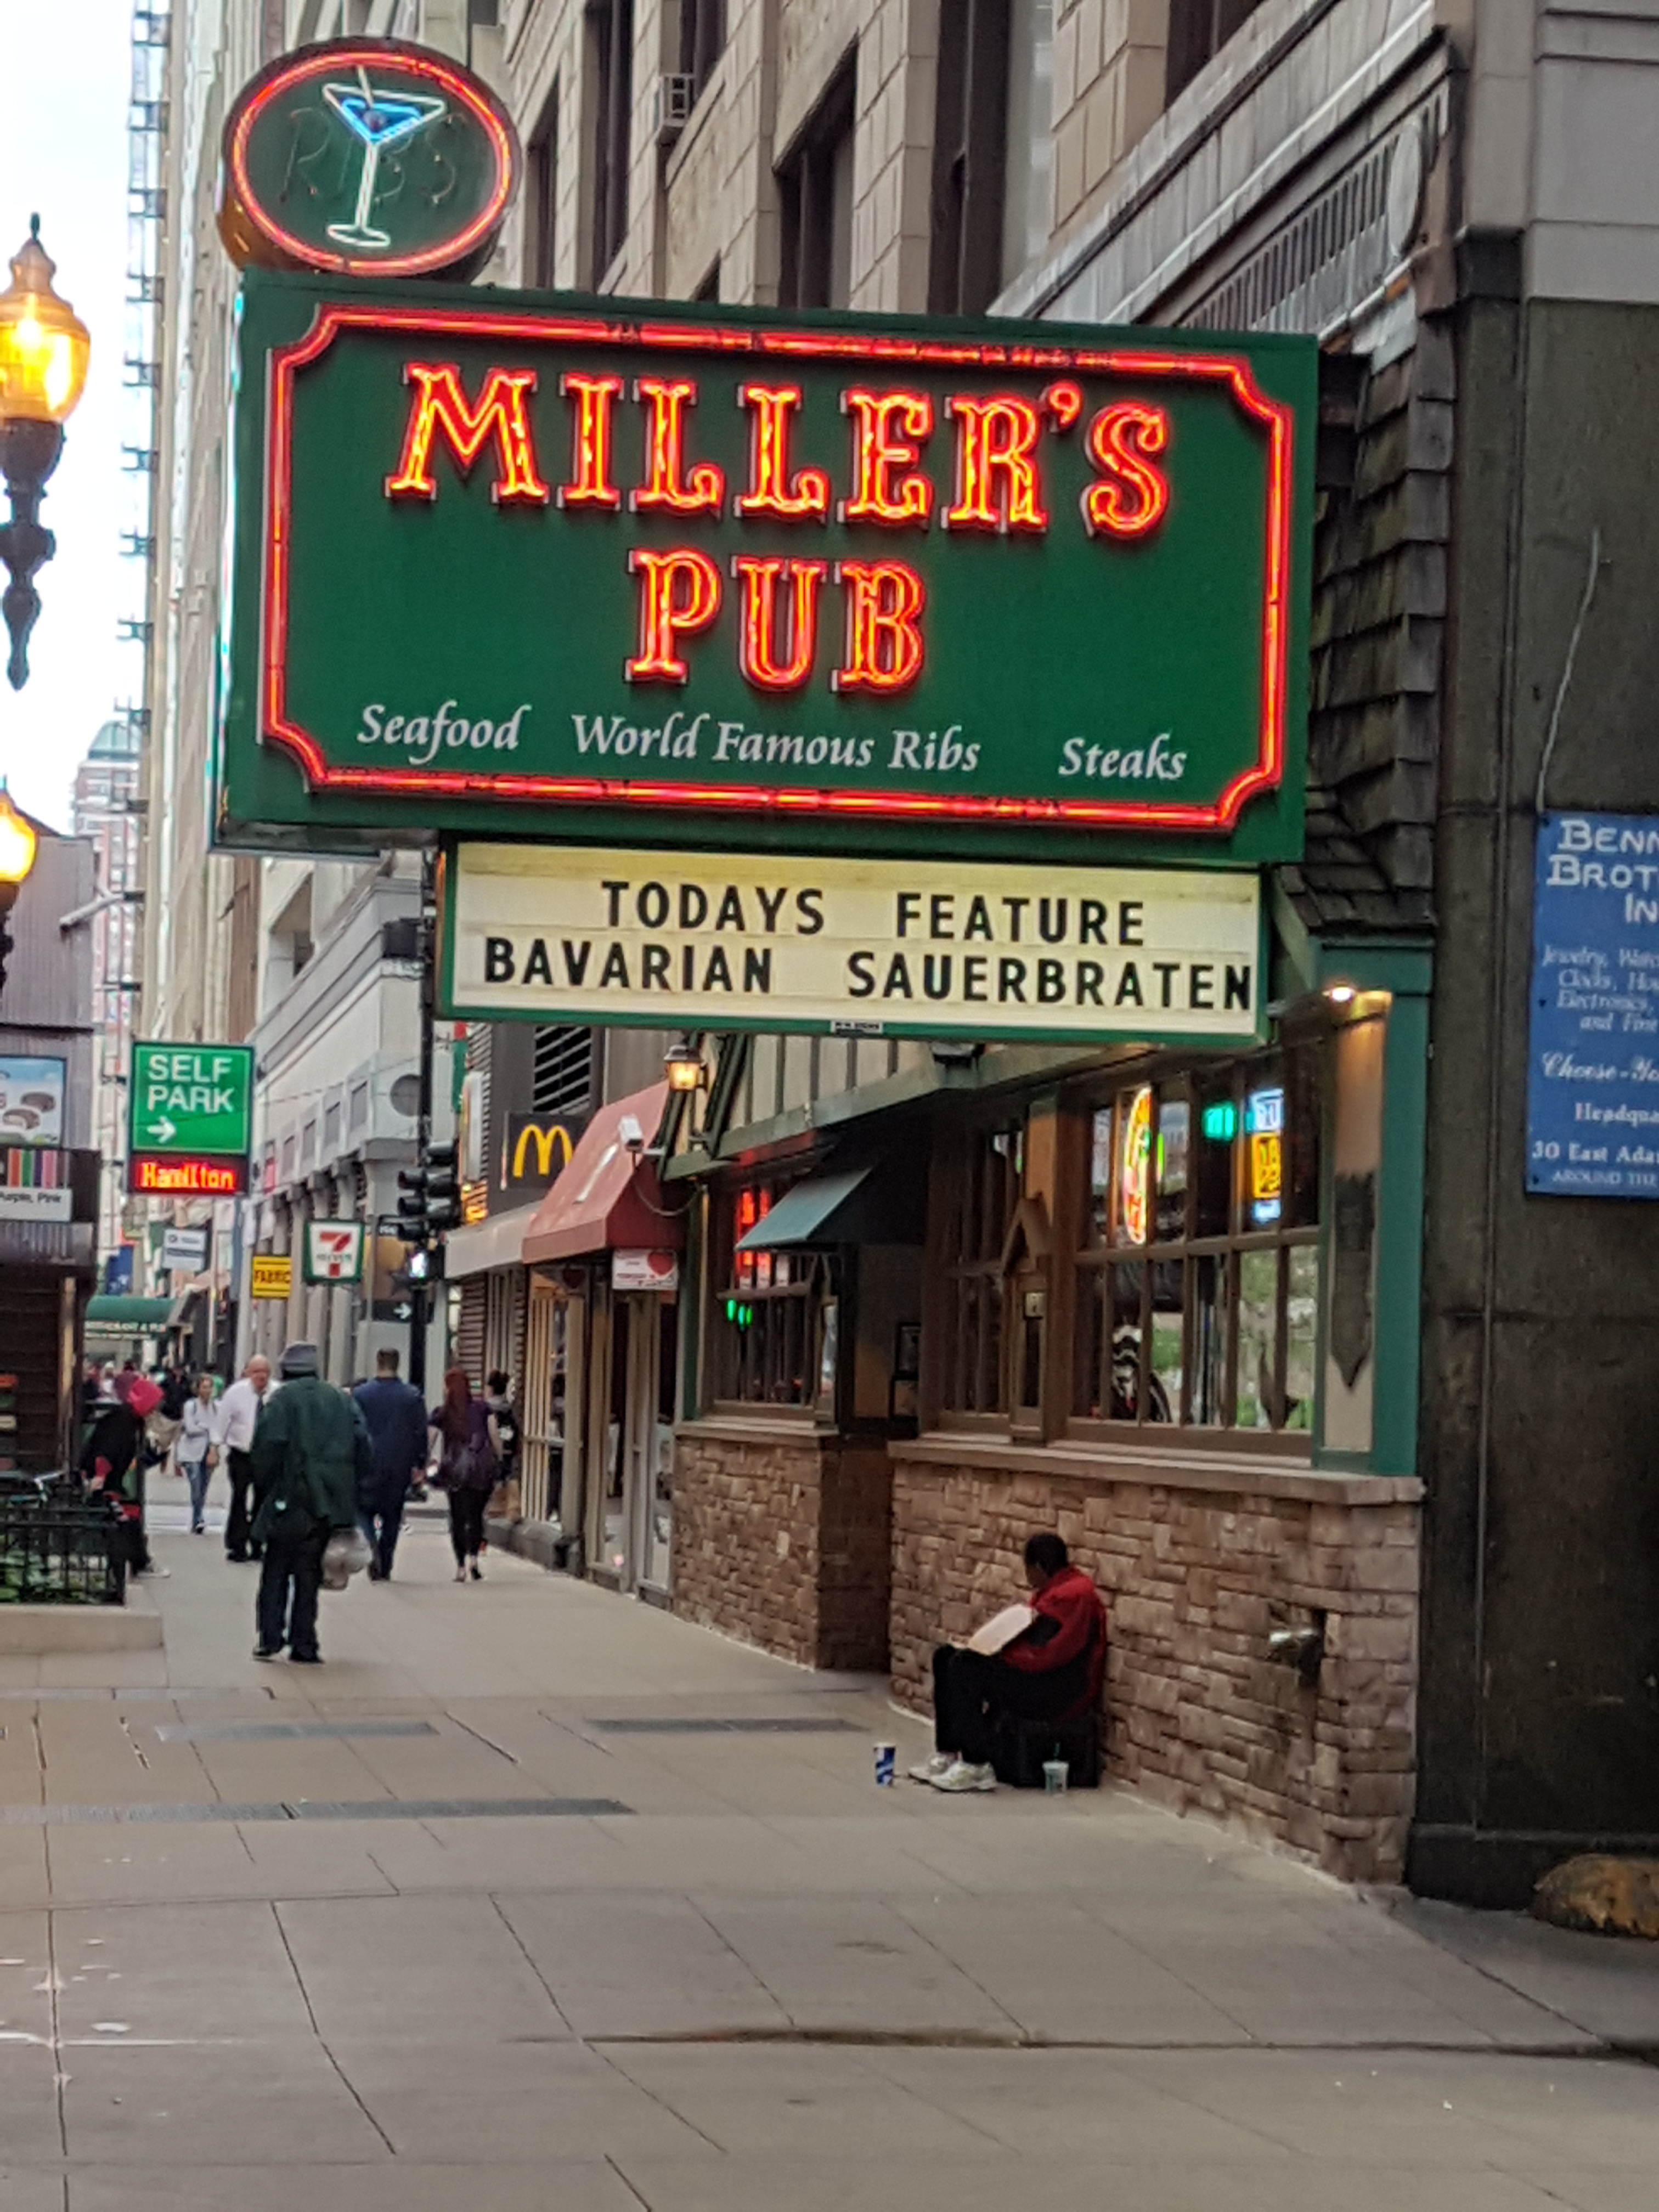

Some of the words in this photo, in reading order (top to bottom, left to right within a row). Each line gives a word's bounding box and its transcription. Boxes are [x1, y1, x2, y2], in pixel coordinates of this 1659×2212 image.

[384, 362, 1172, 538] MILLER'S
[624, 548, 927, 693] PUB
[357, 699, 532, 765] Seafood
[571, 712, 710, 759] World
[712, 721, 874, 767] Famous
[888, 725, 981, 771] Ribs
[1058, 732, 1187, 780] Steaks
[602, 881, 824, 934] TODAYS
[896, 891, 1144, 946] FEATURE
[485, 936, 771, 993] BAVARIAN
[848, 951, 1251, 1010] SAUERBRATEN
[148, 1054, 233, 1082] SELF
[147, 1084, 234, 1113] PARK
[141, 1161, 235, 1189] Hamilton
[1532, 1141, 1560, 1159] 30
[1616, 1146, 1659, 1164] Ada
